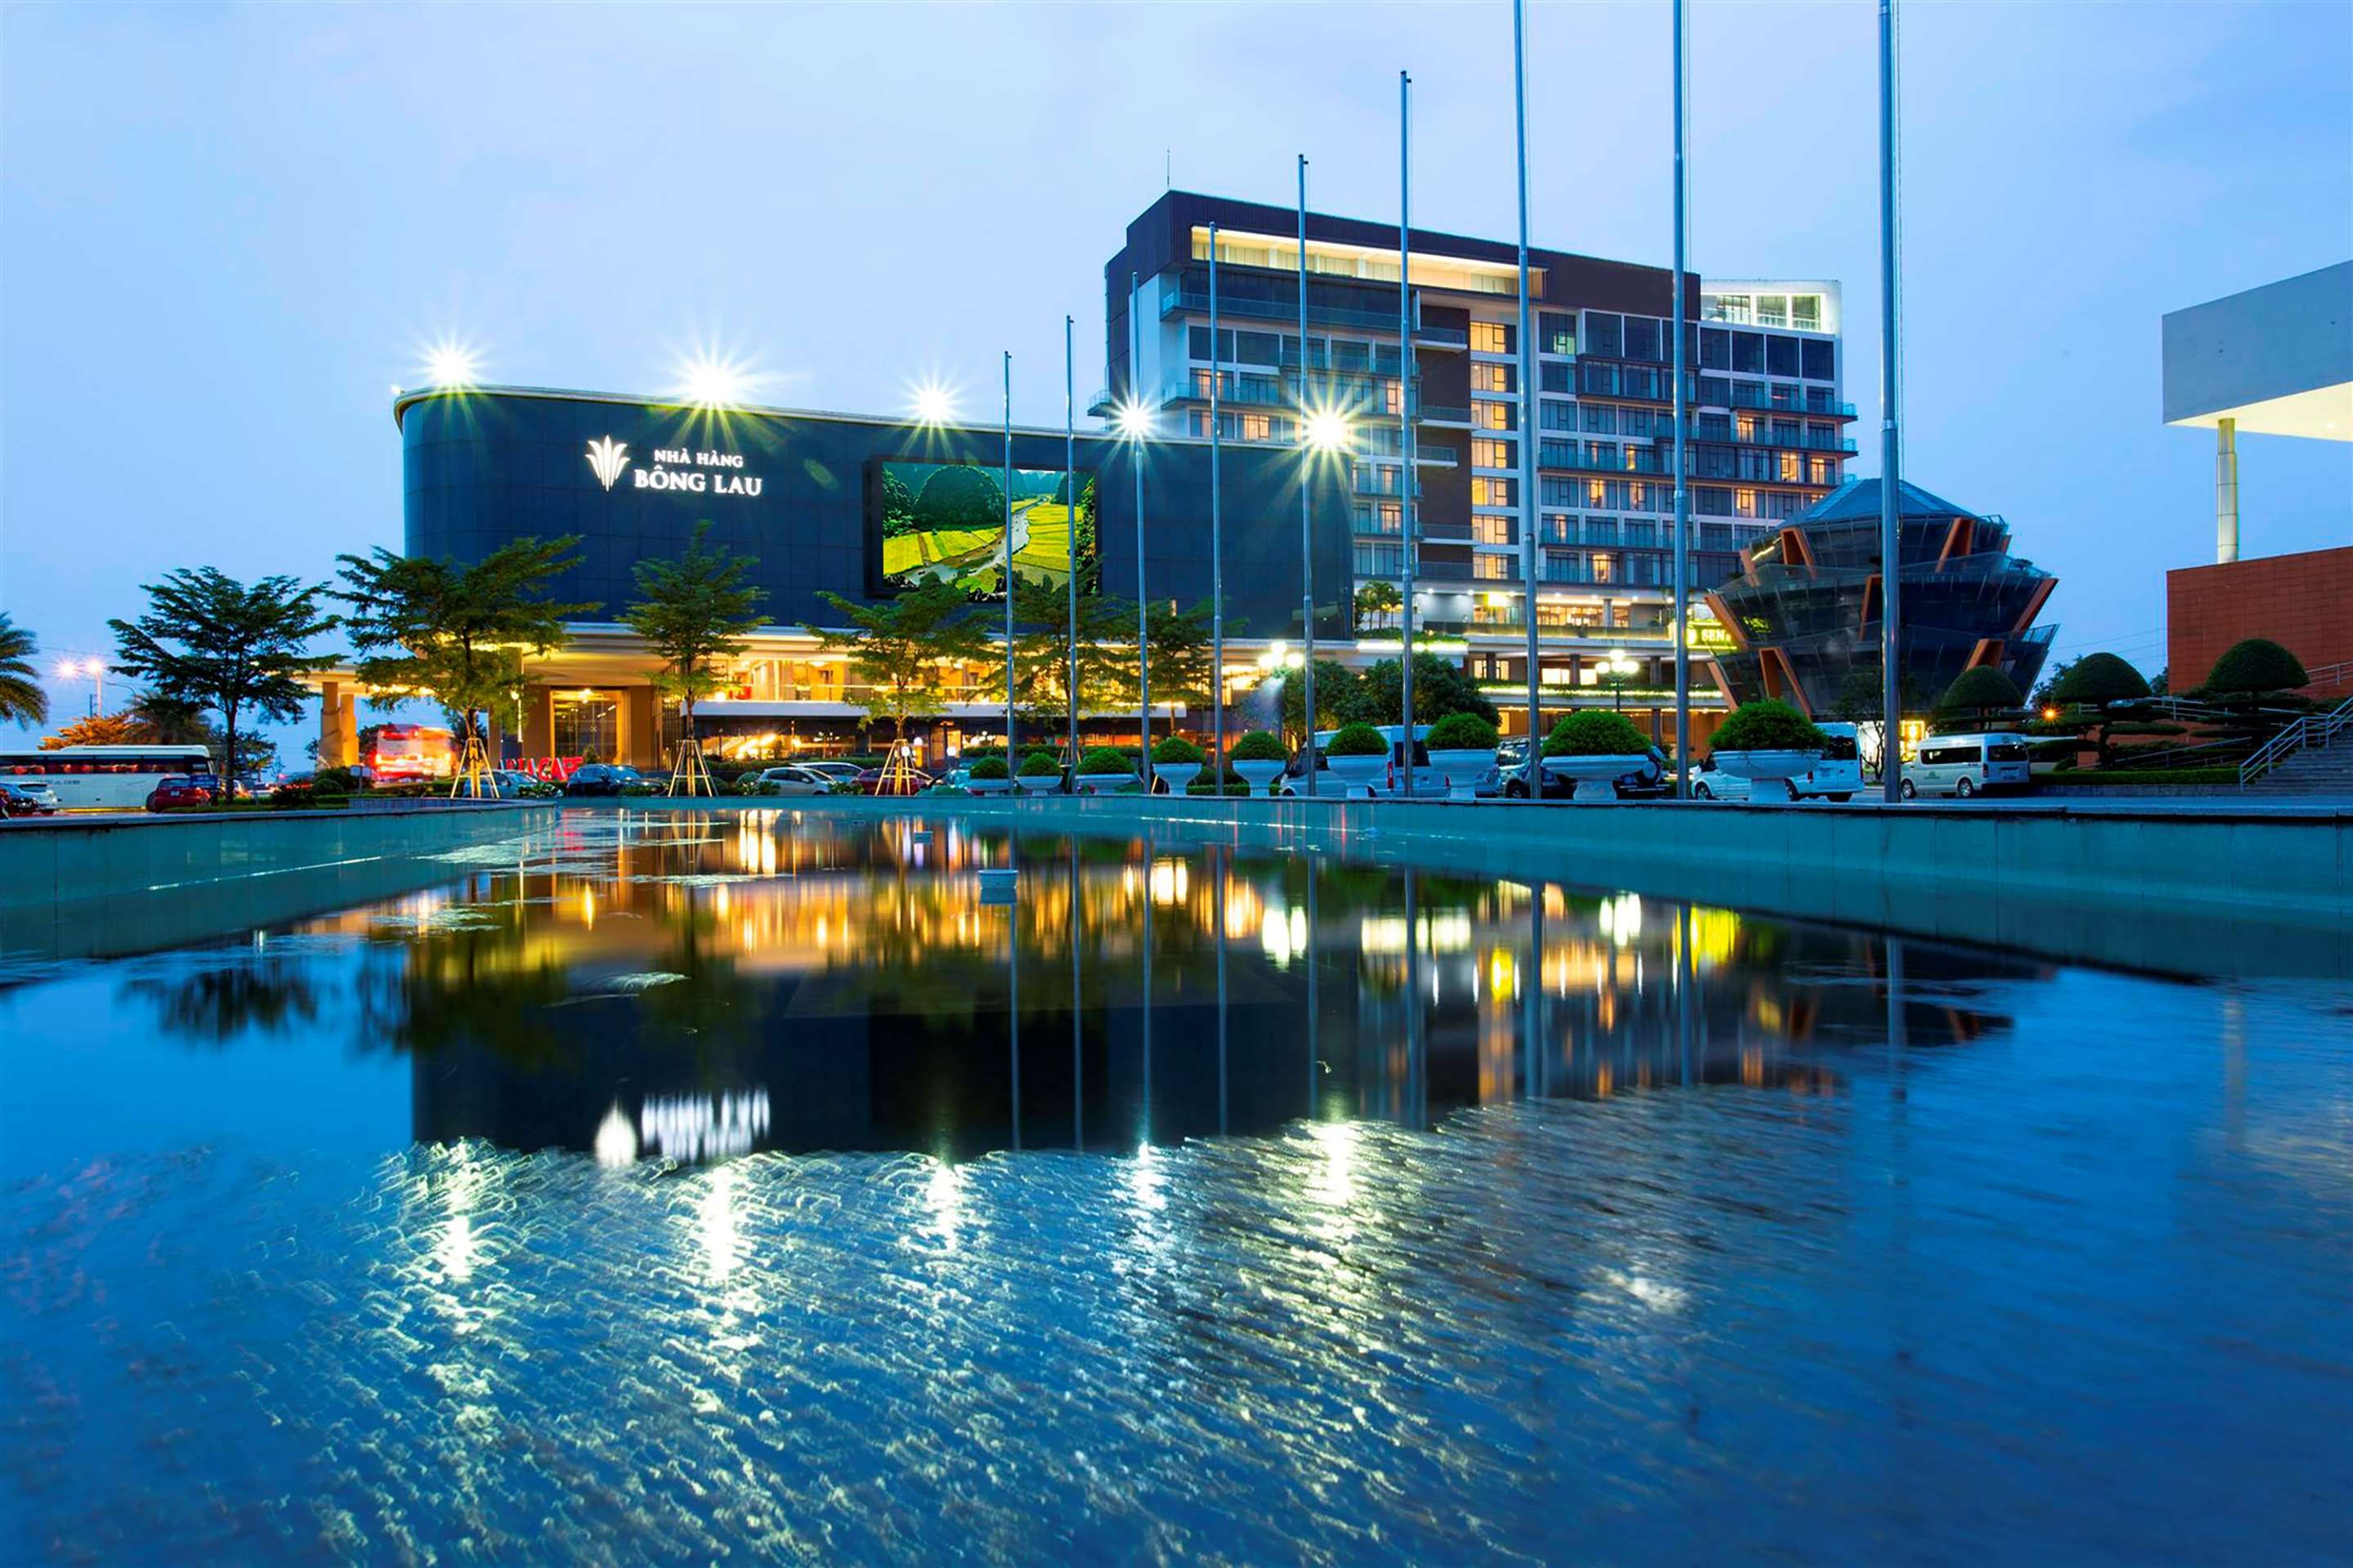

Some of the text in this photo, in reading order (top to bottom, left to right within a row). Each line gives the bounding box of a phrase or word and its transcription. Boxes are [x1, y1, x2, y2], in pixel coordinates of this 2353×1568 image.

[653, 448, 744, 468] NHÀ HÀNG
[633, 464, 763, 496] BÔNG LAU
